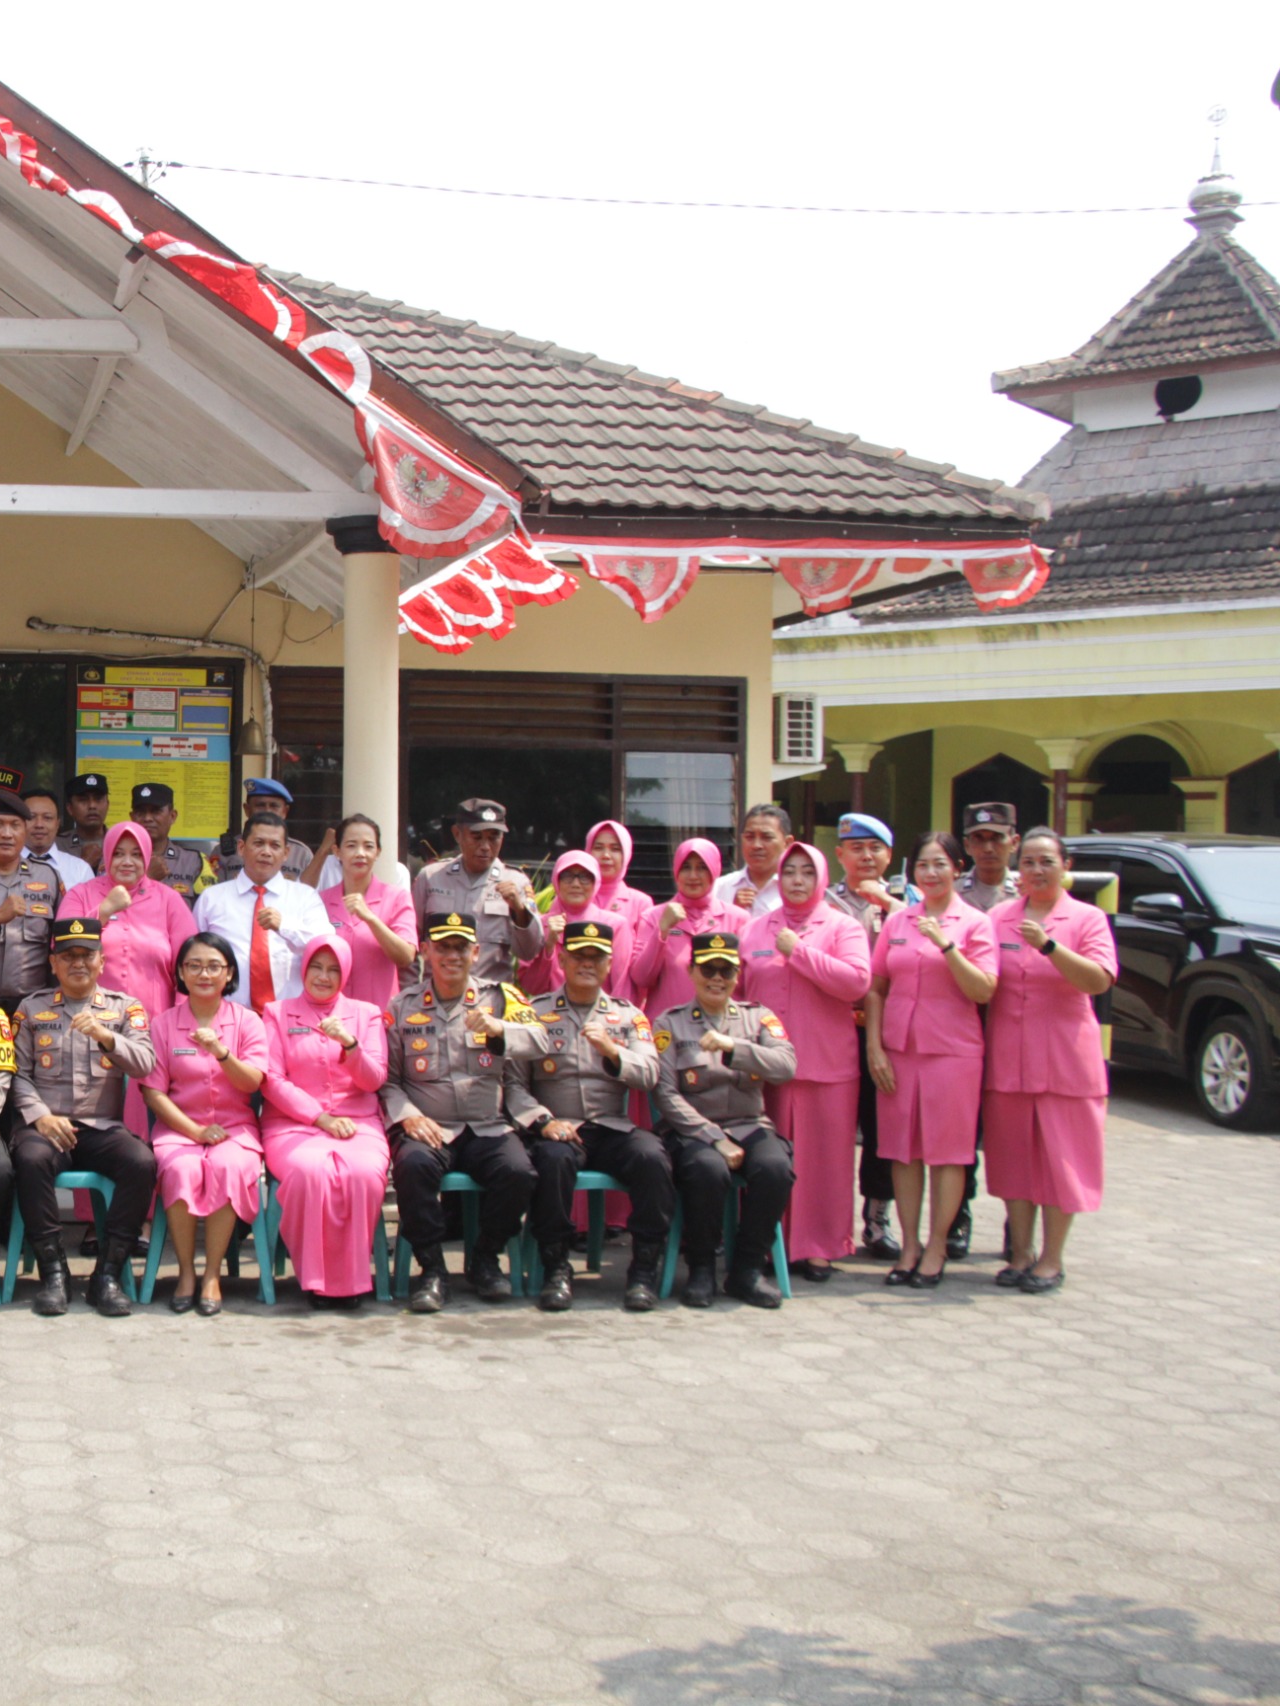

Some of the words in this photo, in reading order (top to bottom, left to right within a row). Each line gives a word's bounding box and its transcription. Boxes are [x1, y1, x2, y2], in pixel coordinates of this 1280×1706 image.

[281, 865, 300, 874] OLRI
[23, 892, 51, 902] POLRI
[0, 1046, 16, 1063] OP
